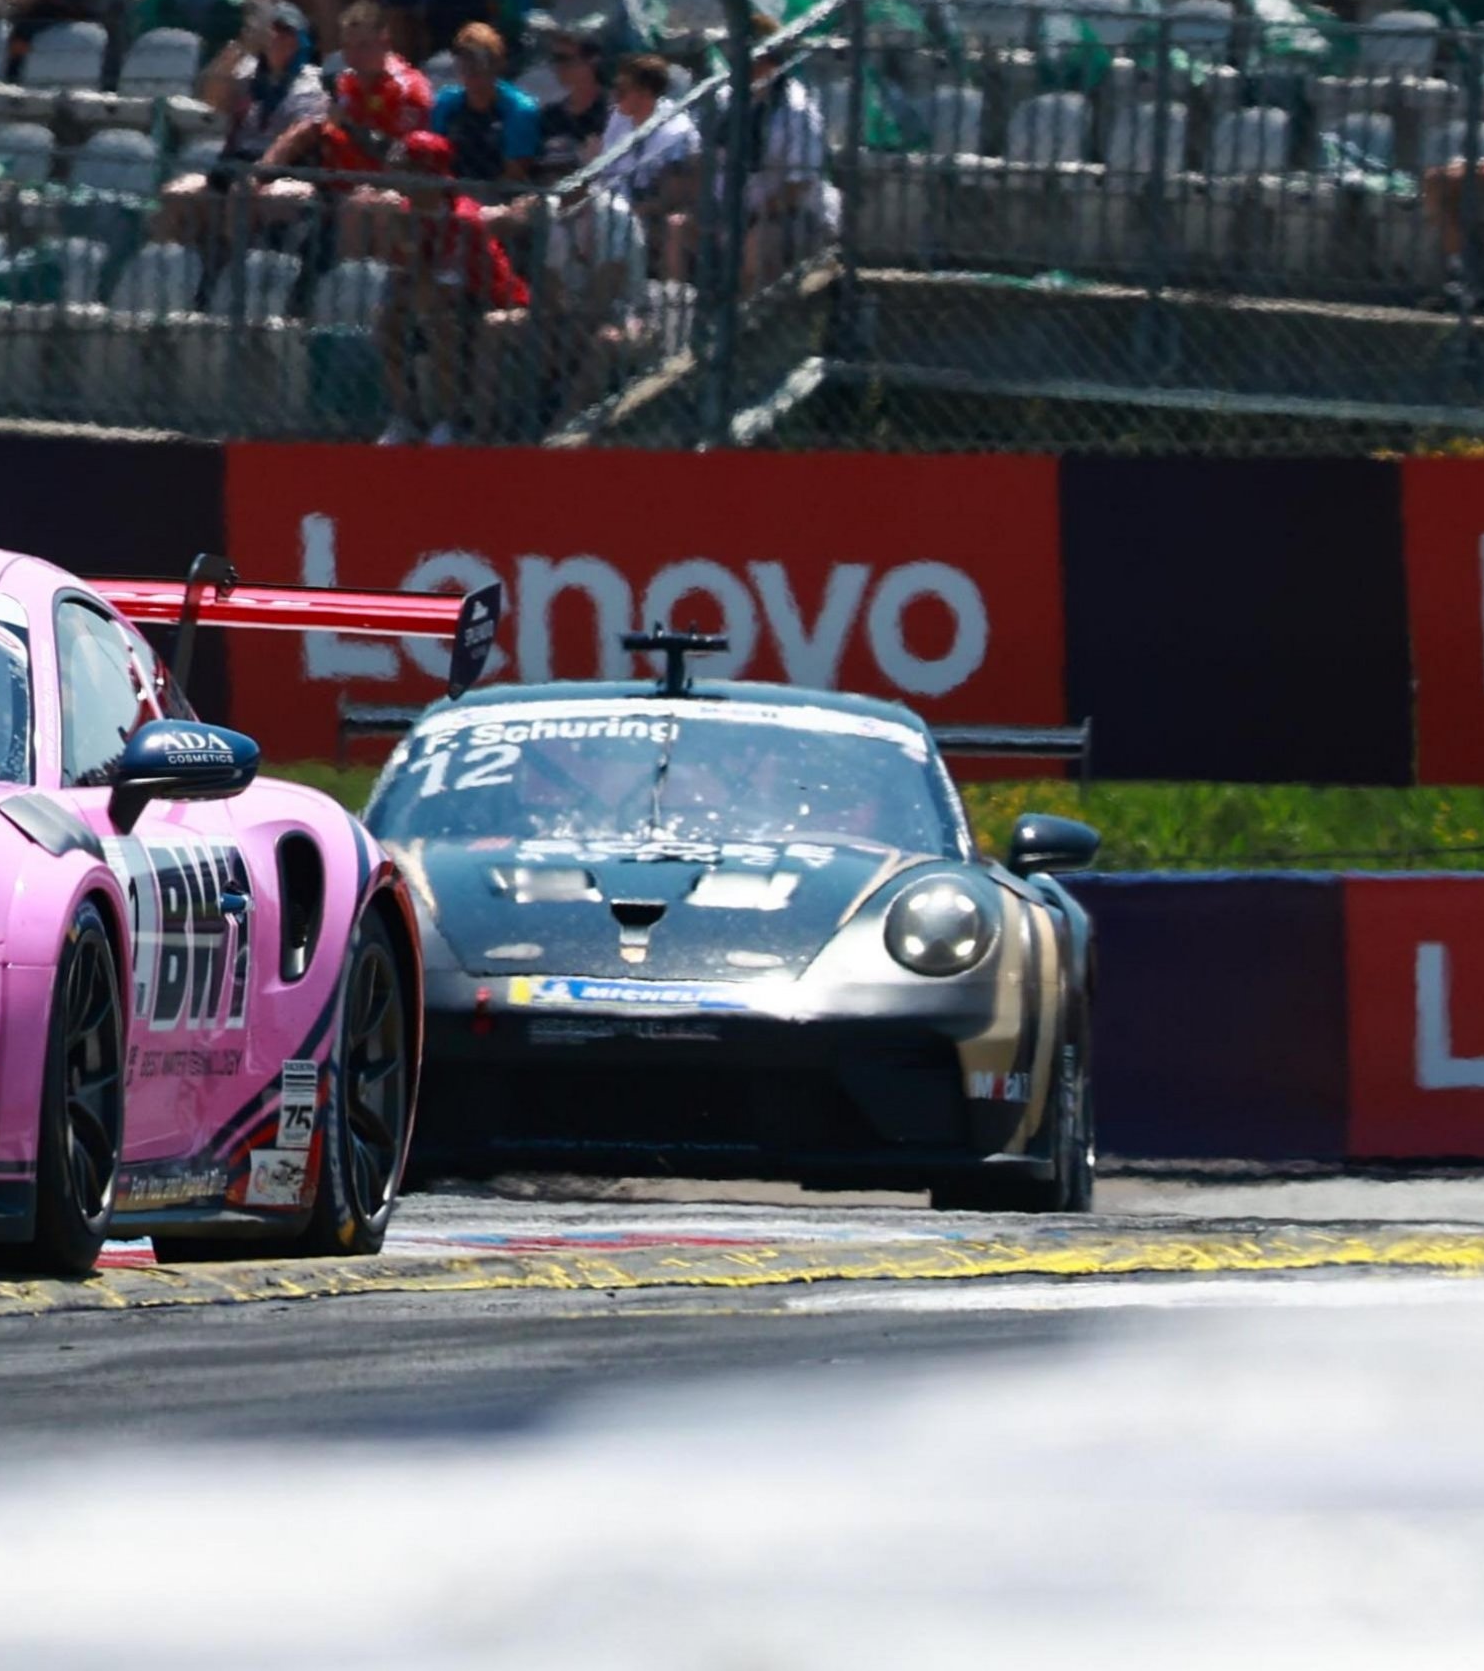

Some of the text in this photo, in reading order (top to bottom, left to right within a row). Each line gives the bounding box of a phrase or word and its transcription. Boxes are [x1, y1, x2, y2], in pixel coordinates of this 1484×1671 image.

[299, 513, 990, 698] Lenovo
[162, 731, 232, 752] ADA
[422, 714, 680, 756] F. Schuring
[167, 753, 235, 765] COSMETICS
[408, 743, 522, 798] 12
[282, 1104, 313, 1130] 75
